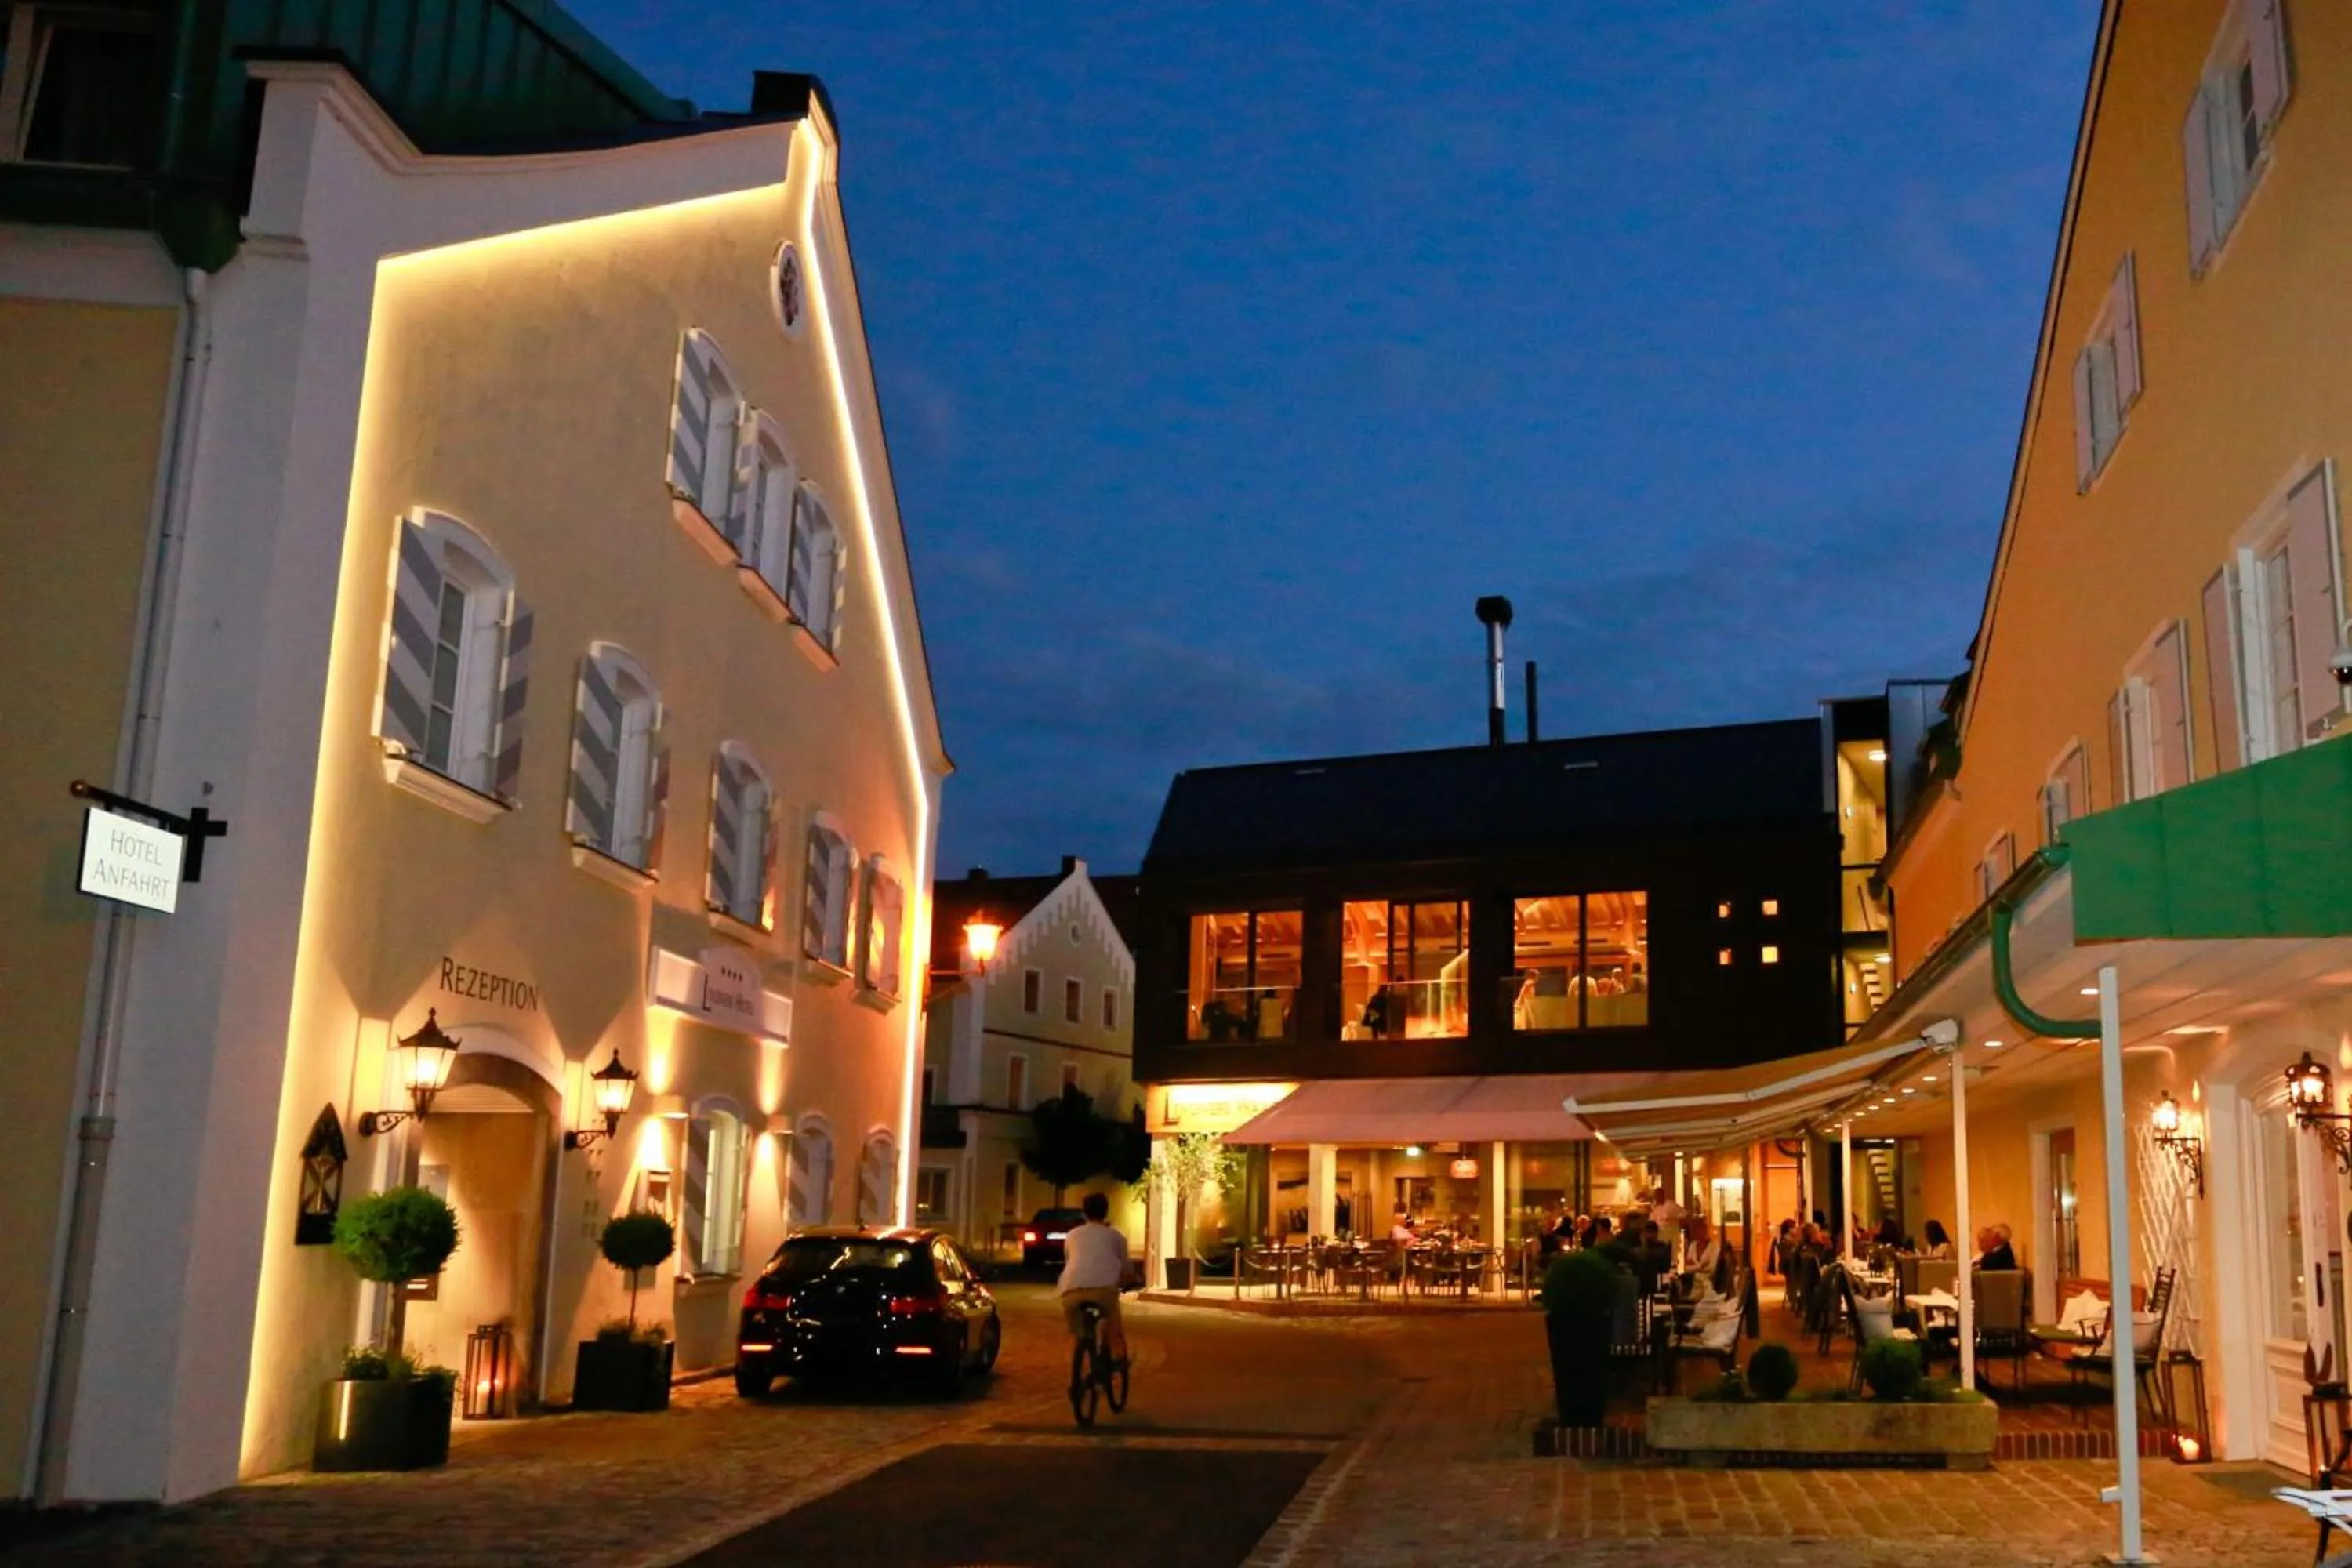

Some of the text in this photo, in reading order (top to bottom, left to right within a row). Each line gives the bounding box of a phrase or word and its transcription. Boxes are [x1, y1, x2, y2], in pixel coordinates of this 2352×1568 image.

[111, 828, 162, 866] HOTEL
[93, 858, 171, 898] ANFAHRT
[439, 956, 539, 1012] REZEPTION
